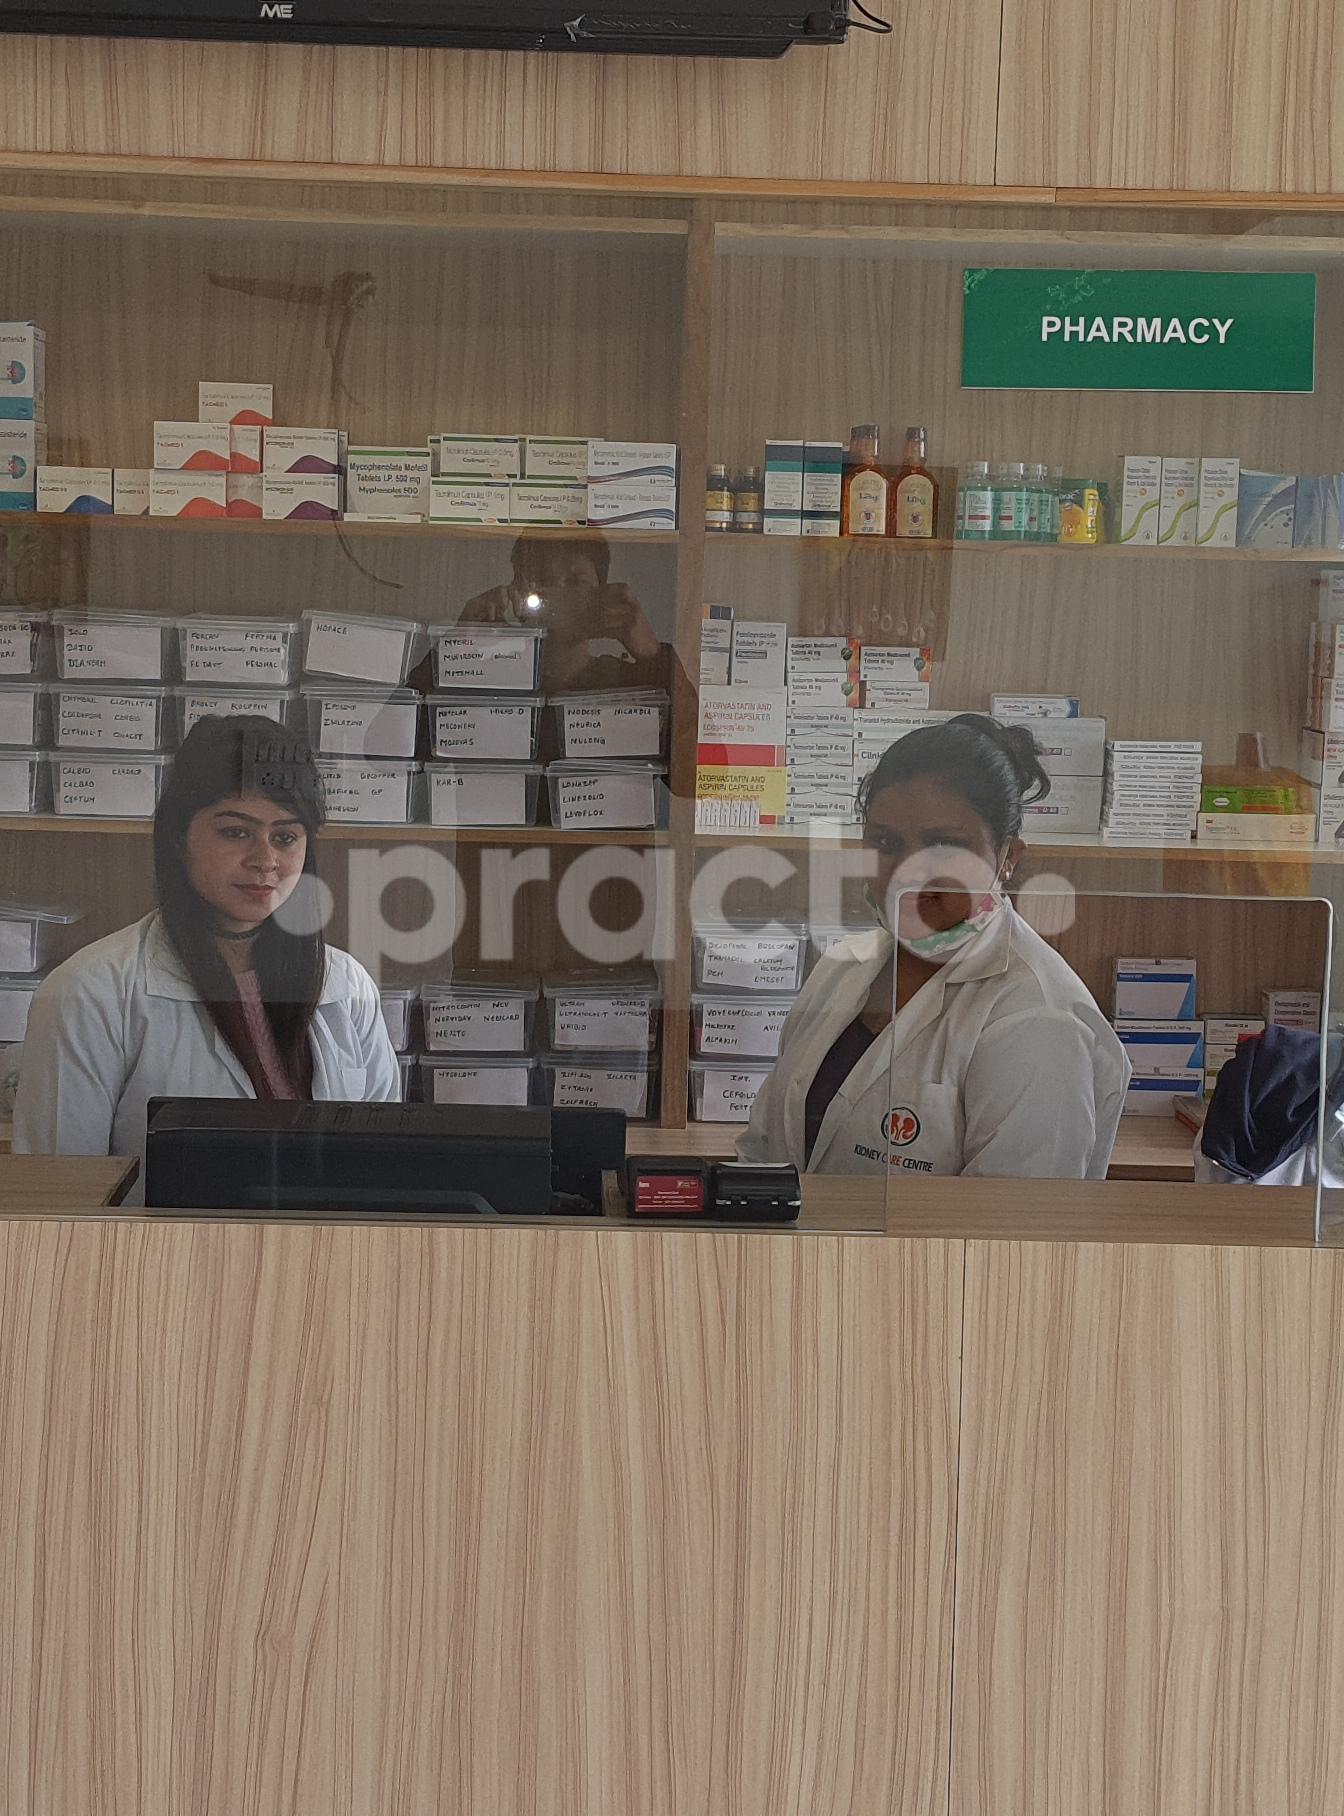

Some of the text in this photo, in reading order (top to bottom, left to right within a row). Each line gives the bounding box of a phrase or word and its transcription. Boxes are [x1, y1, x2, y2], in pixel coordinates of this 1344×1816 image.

[1041, 316, 1234, 344] PHARMACY
[704, 702, 772, 712] ATORVASTATIN AND
[698, 774, 766, 784] ATORVASTATIN AND
[854, 1143, 881, 1161] KIDNEY
[902, 1157, 934, 1172] CENTRE
